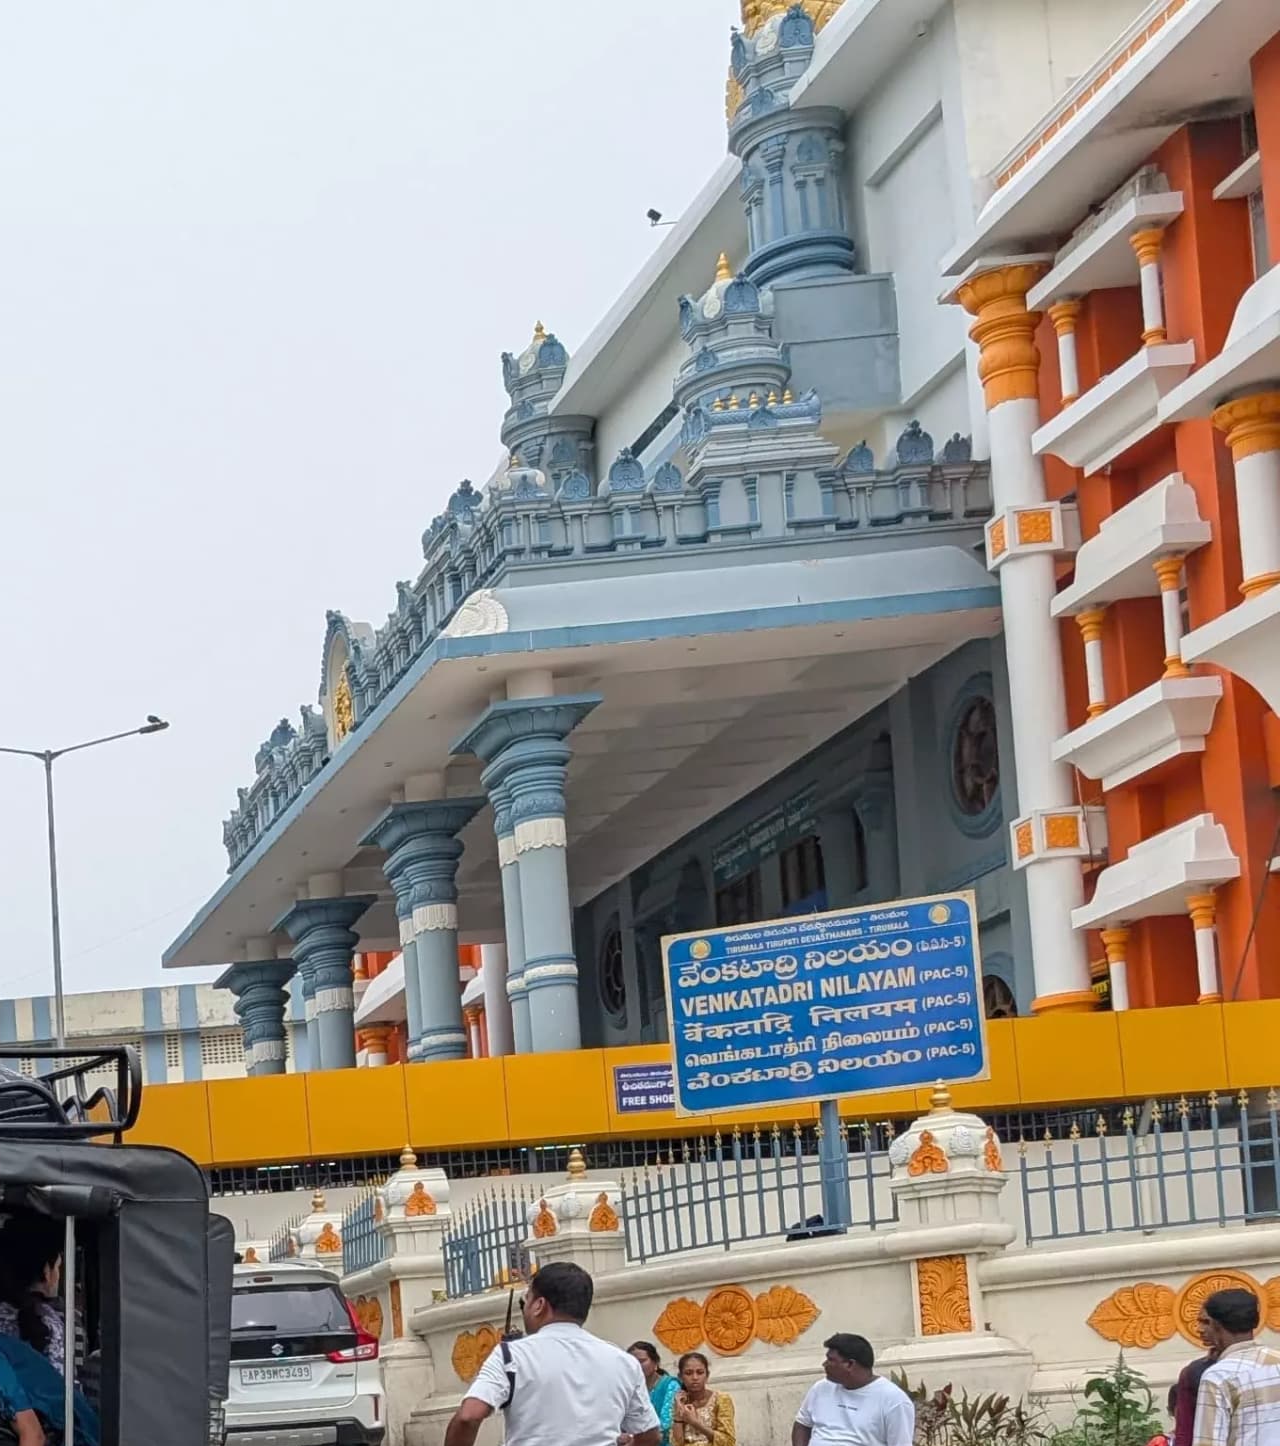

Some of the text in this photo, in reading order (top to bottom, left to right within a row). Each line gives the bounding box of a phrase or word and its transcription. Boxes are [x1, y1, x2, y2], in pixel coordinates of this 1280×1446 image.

[869, 921, 909, 934] TIRUMALA
[804, 939, 913, 971] నిలయం
[680, 965, 968, 1017] VENKATADRI NILAYAM (PAC-5)
[921, 992, 971, 1011] (PAC-5)
[821, 1021, 920, 1054] நிலையம்
[924, 1018, 973, 1037] (PAC-5)
[926, 1043, 976, 1062] (PAC-5)
[622, 1095, 647, 1106] FREE
